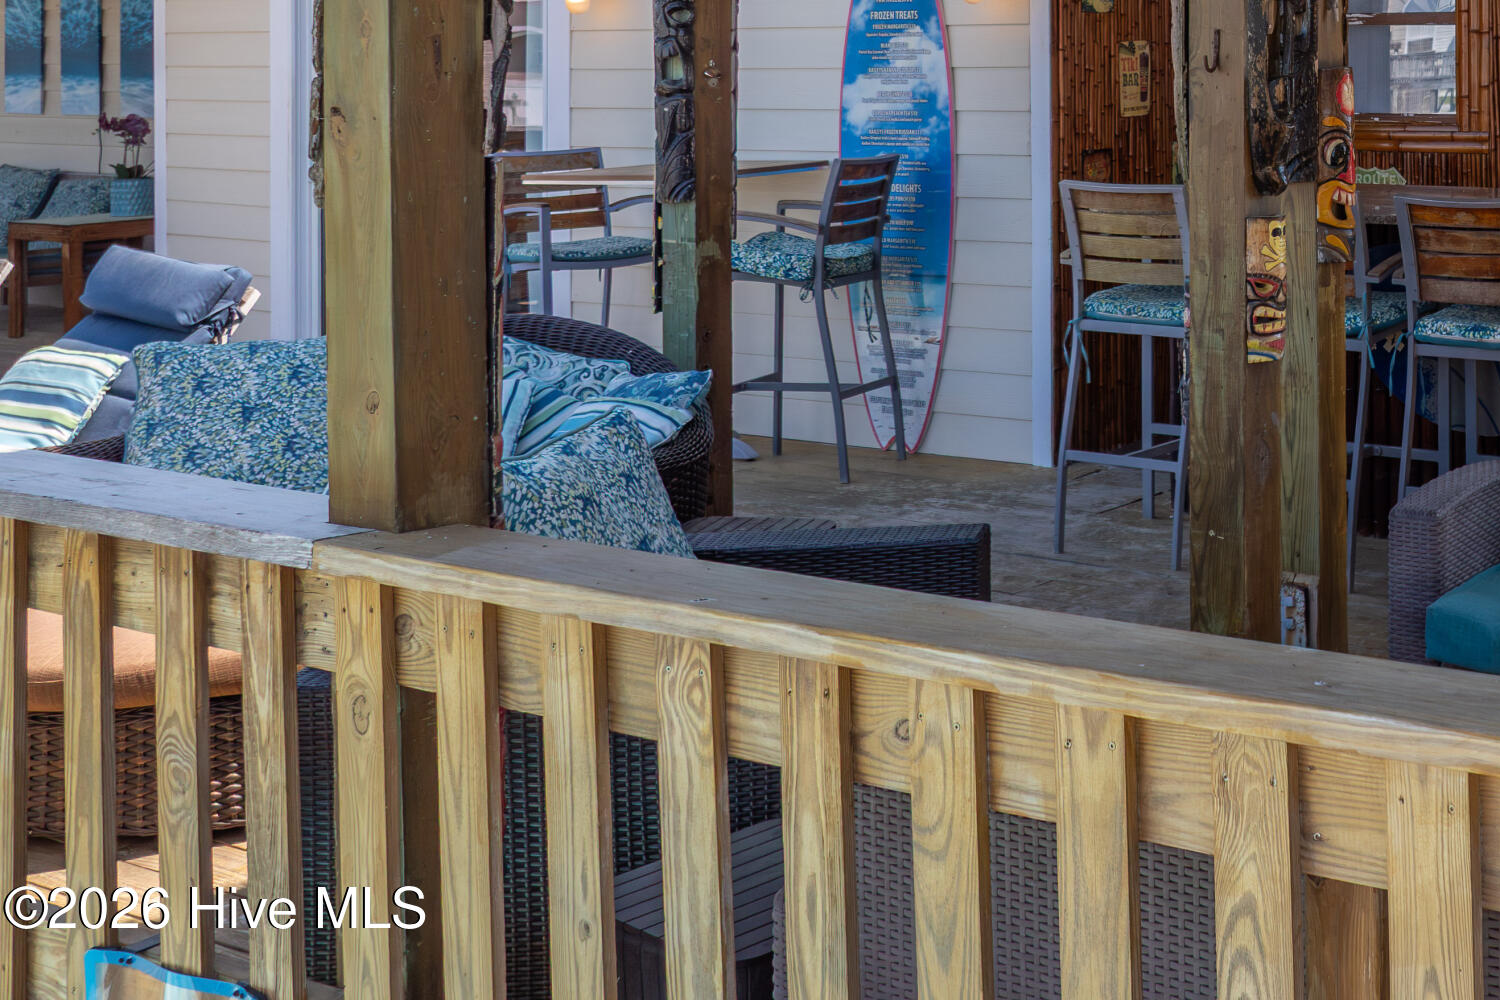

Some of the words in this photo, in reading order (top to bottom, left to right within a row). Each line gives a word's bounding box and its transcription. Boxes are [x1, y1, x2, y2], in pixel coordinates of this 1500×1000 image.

[870, 11, 895, 20] FROZEN
[896, 10, 919, 20] TREATS
[1122, 73, 1139, 87] BAR
[1355, 173, 1396, 185] ROUTE
[891, 184, 922, 193] DELIGHTS
